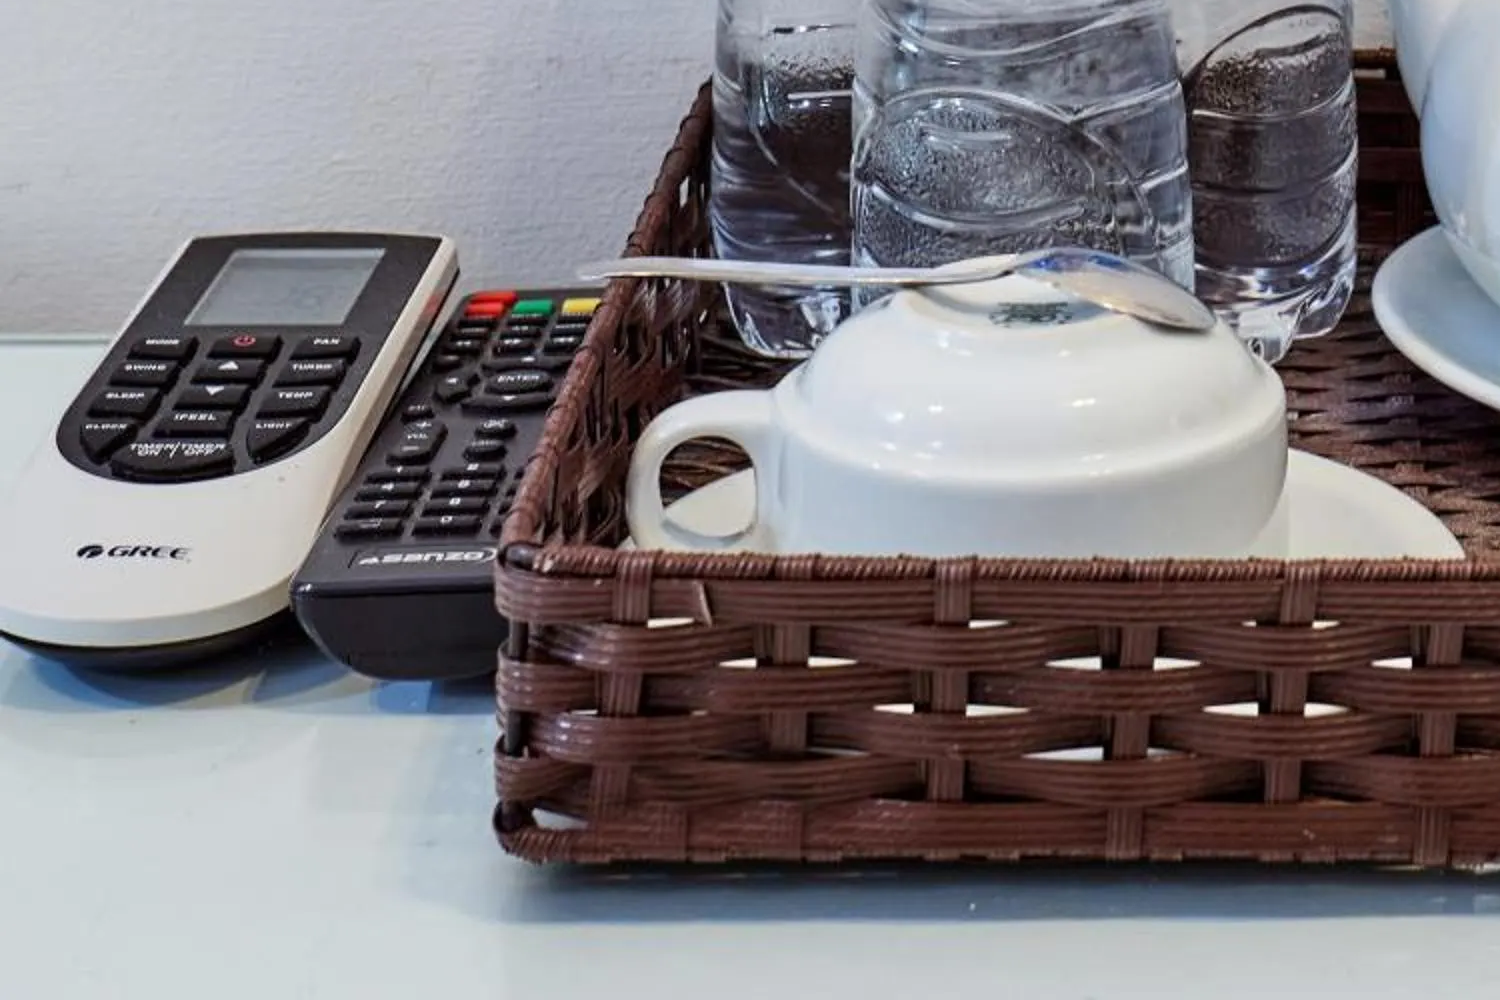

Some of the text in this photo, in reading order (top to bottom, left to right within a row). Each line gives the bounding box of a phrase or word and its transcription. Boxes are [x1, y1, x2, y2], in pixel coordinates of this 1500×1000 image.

[497, 374, 540, 383] ENTER
[278, 391, 313, 399] TEMP
[107, 544, 192, 561] GREE
